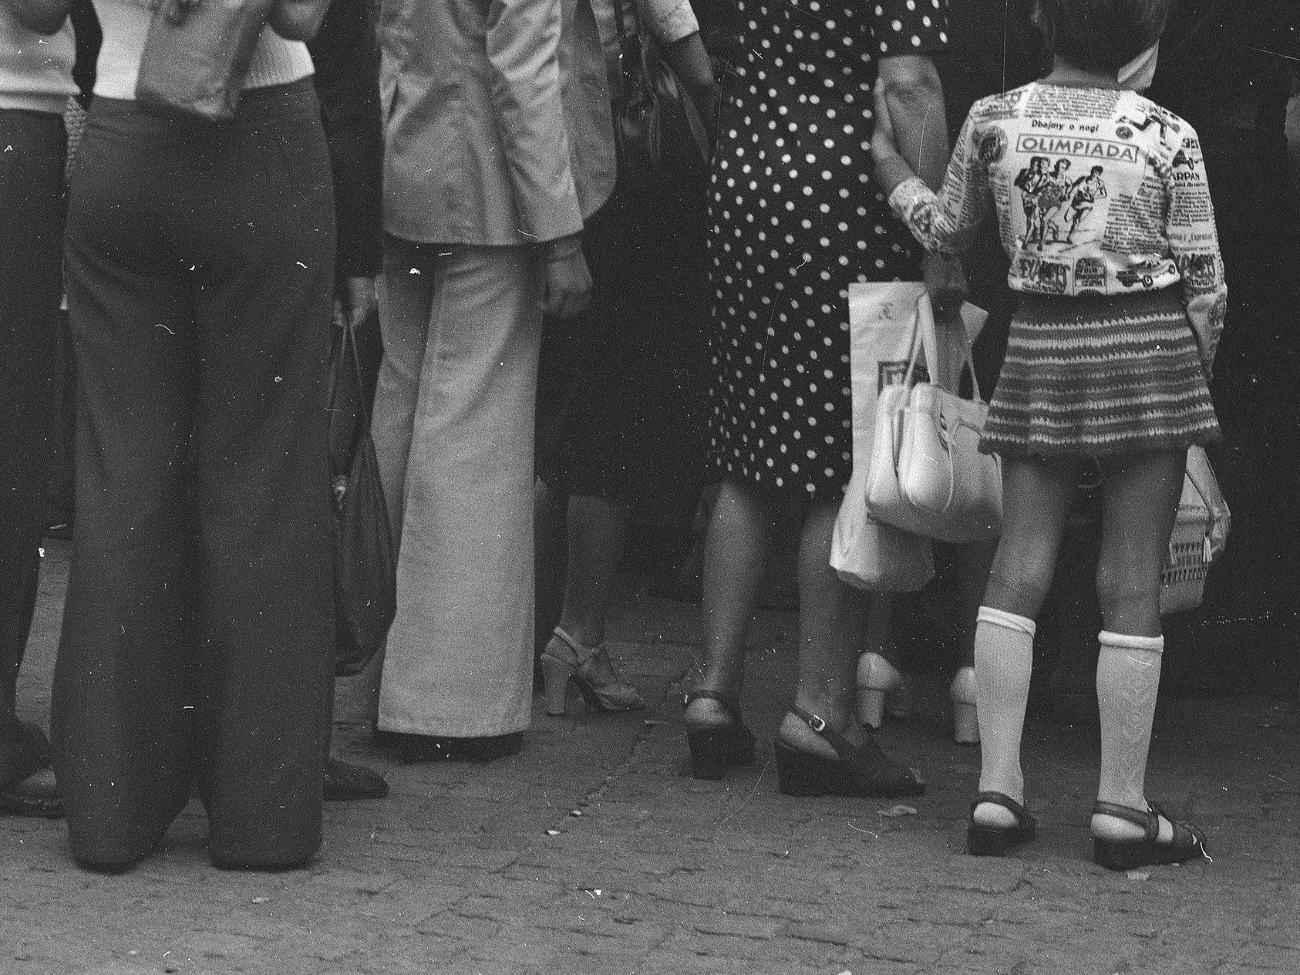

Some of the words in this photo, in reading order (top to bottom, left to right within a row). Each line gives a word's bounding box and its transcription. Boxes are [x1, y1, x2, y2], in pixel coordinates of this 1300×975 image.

[1031, 119, 1064, 131] Dbajmy
[1079, 124, 1099, 133] nogi
[1022, 137, 1134, 161] OLIMPIADA
